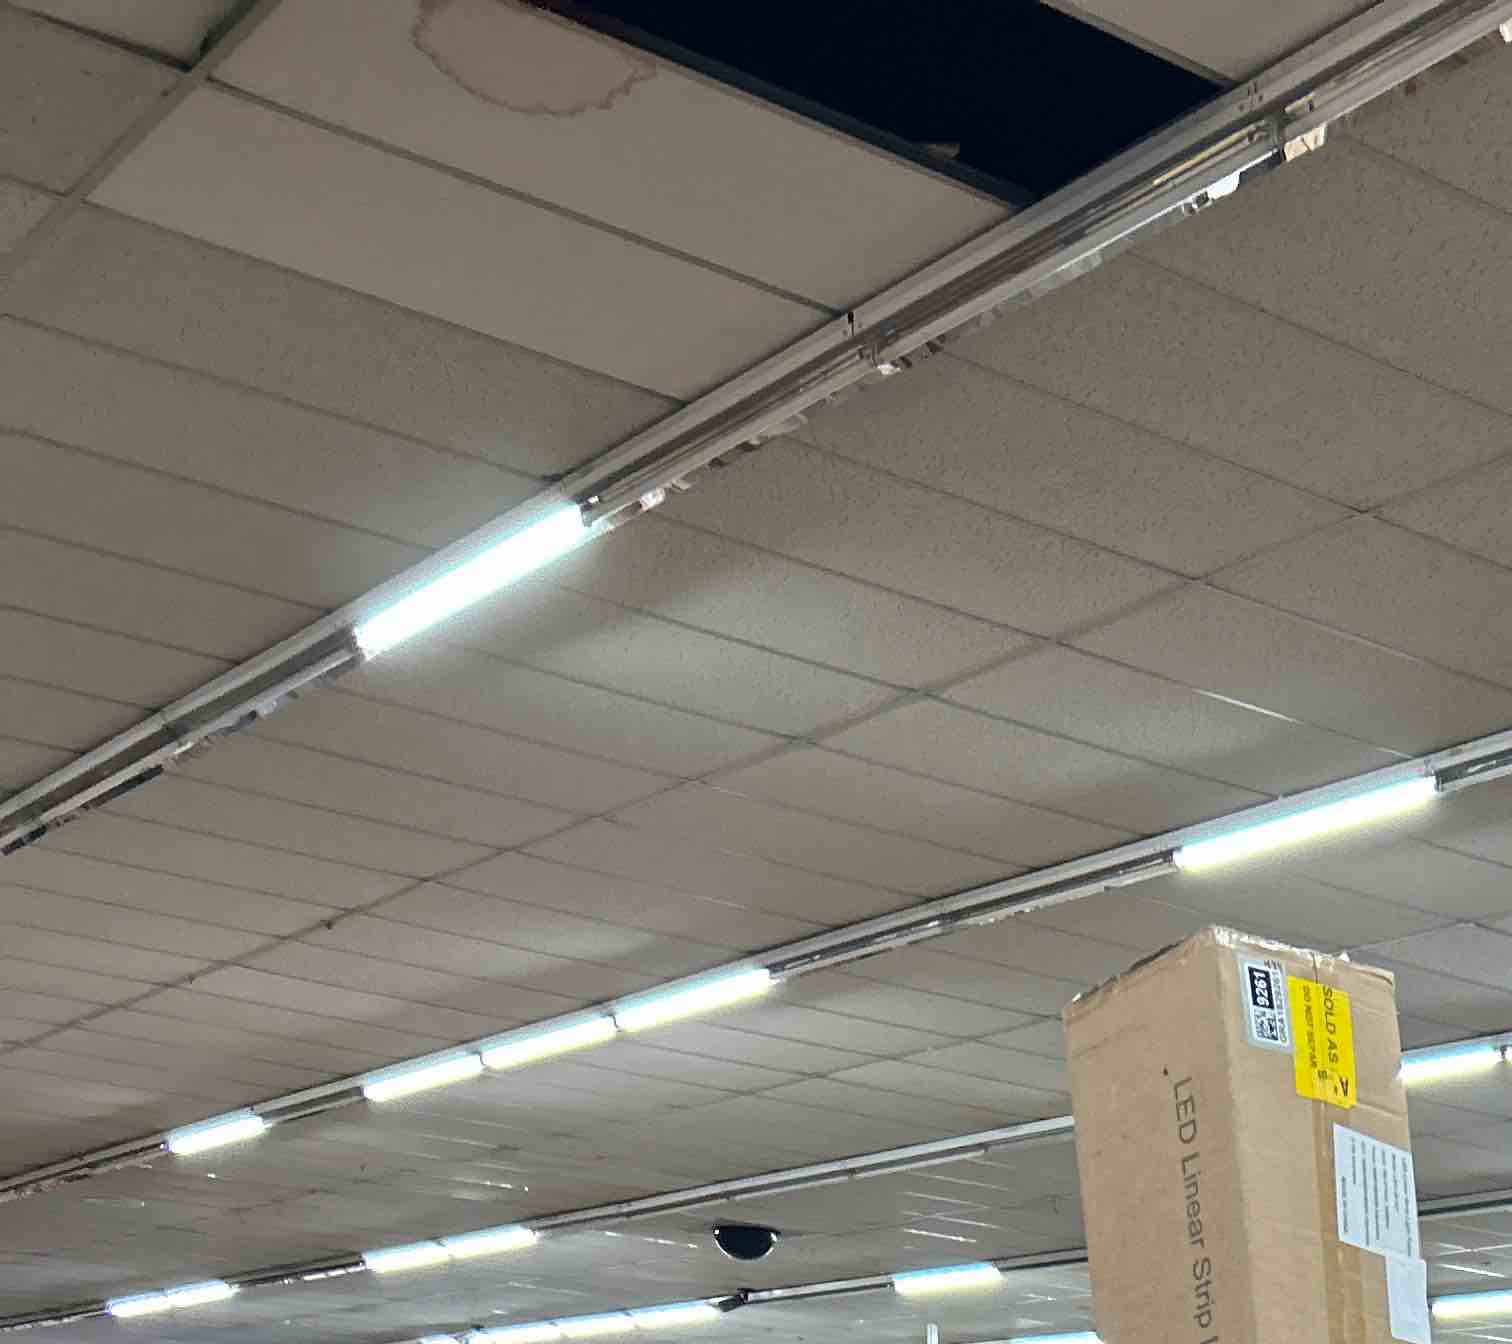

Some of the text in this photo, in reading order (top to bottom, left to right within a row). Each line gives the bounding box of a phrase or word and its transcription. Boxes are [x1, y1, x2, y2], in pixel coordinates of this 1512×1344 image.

[1253, 971, 1270, 1008] 9261
[1322, 986, 1340, 1064] SOLD AS
[1172, 1076, 1198, 1145] LED
[1180, 1151, 1206, 1250] Linear
[1192, 1256, 1215, 1329] Strip
